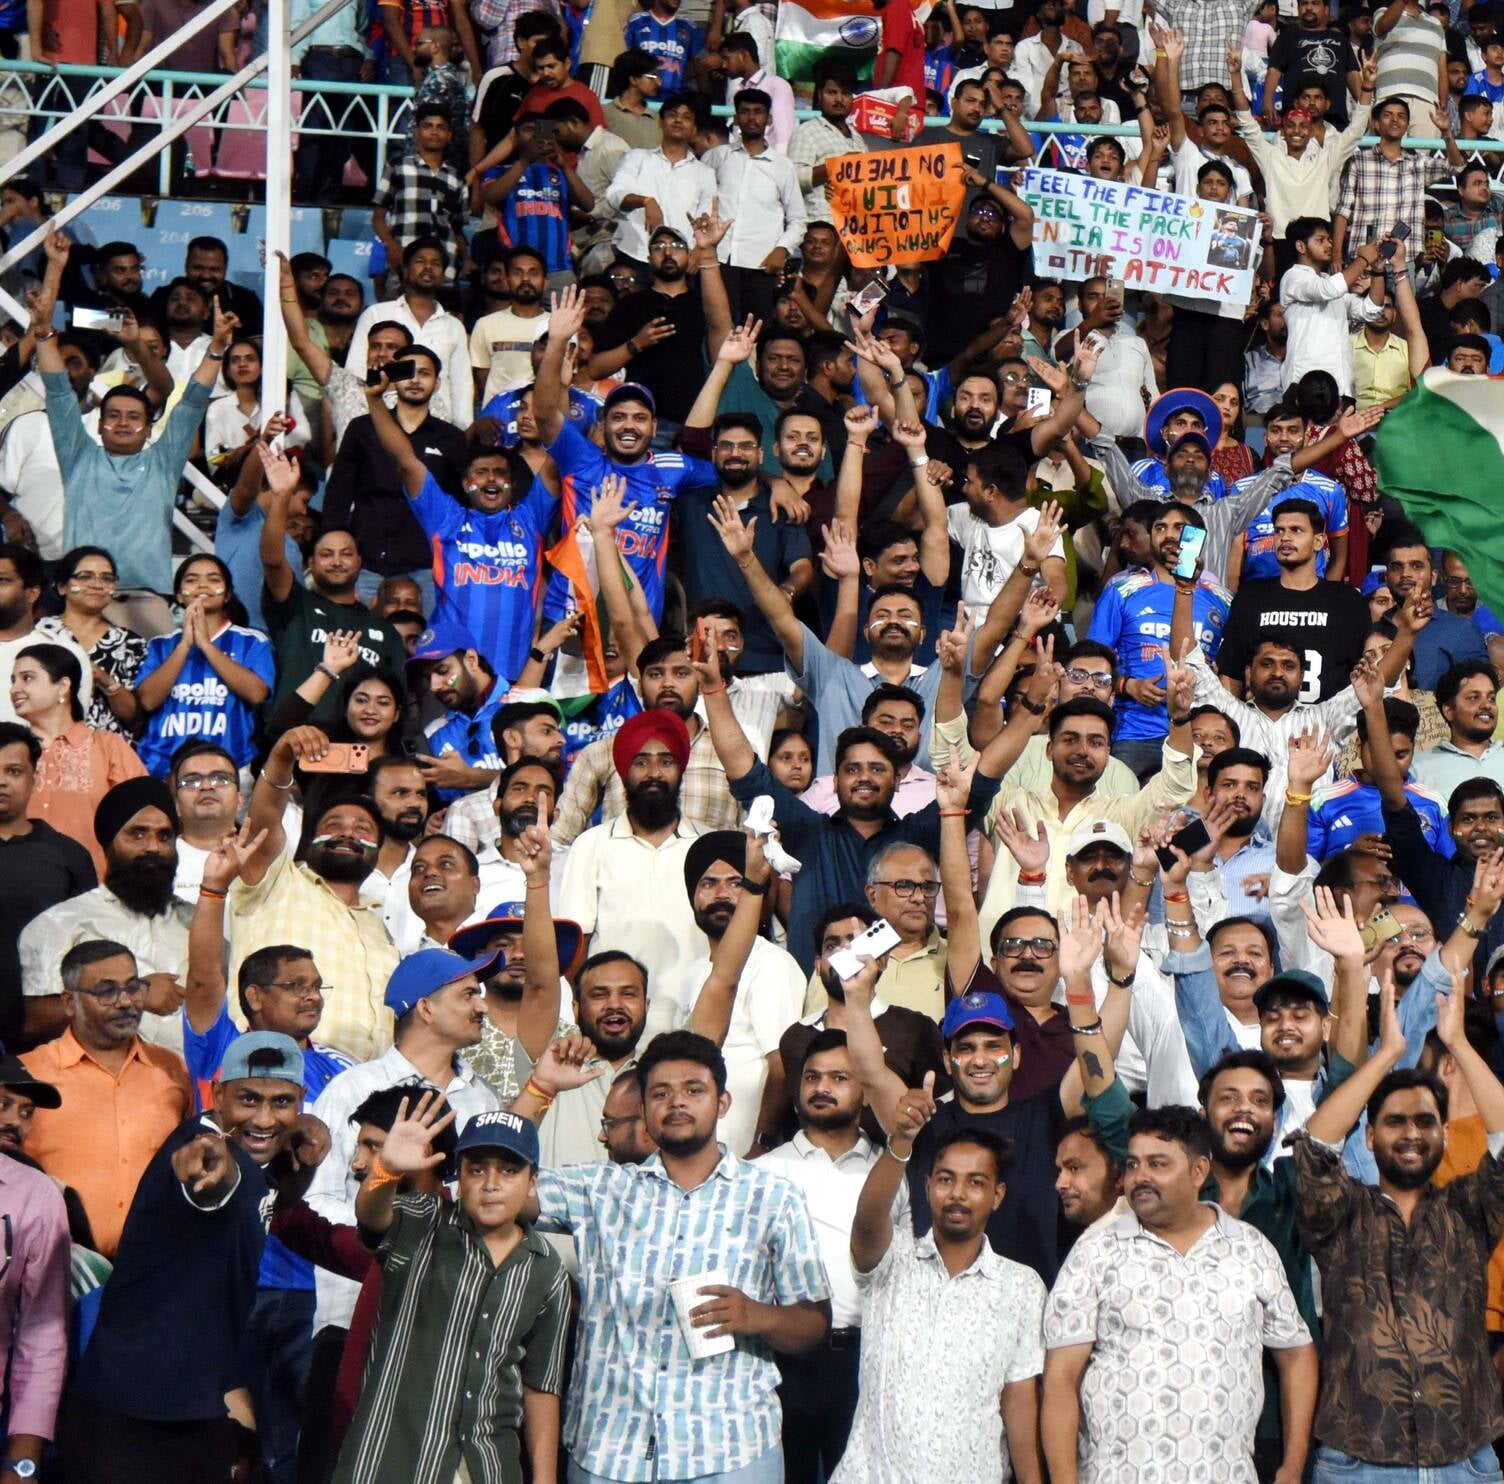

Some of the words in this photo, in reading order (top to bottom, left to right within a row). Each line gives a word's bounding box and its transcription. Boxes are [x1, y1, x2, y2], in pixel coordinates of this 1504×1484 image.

[640, 40, 685, 55] apollo
[835, 159, 865, 184] TOP
[867, 156, 912, 183] THE
[919, 153, 946, 180] ON
[863, 183, 950, 212] INDIA
[1025, 169, 1077, 197] FEEL
[1082, 179, 1118, 205] THE
[1124, 187, 1187, 217] FIRE
[1025, 193, 1082, 221] FEEL
[1089, 201, 1132, 229] THE
[897, 225, 947, 253] ARAM
[1110, 230, 1143, 256] IS
[1152, 238, 1183, 262] ON
[1067, 249, 1117, 279] THE
[1123, 258, 1235, 296] ATTACK
[628, 506, 665, 526] ollo
[453, 561, 529, 591] INDIA
[1259, 611, 1329, 628] HOUSTON
[170, 676, 229, 704] apollo
[161, 710, 227, 739] INDIA
[475, 1111, 524, 1134] SHEIN
